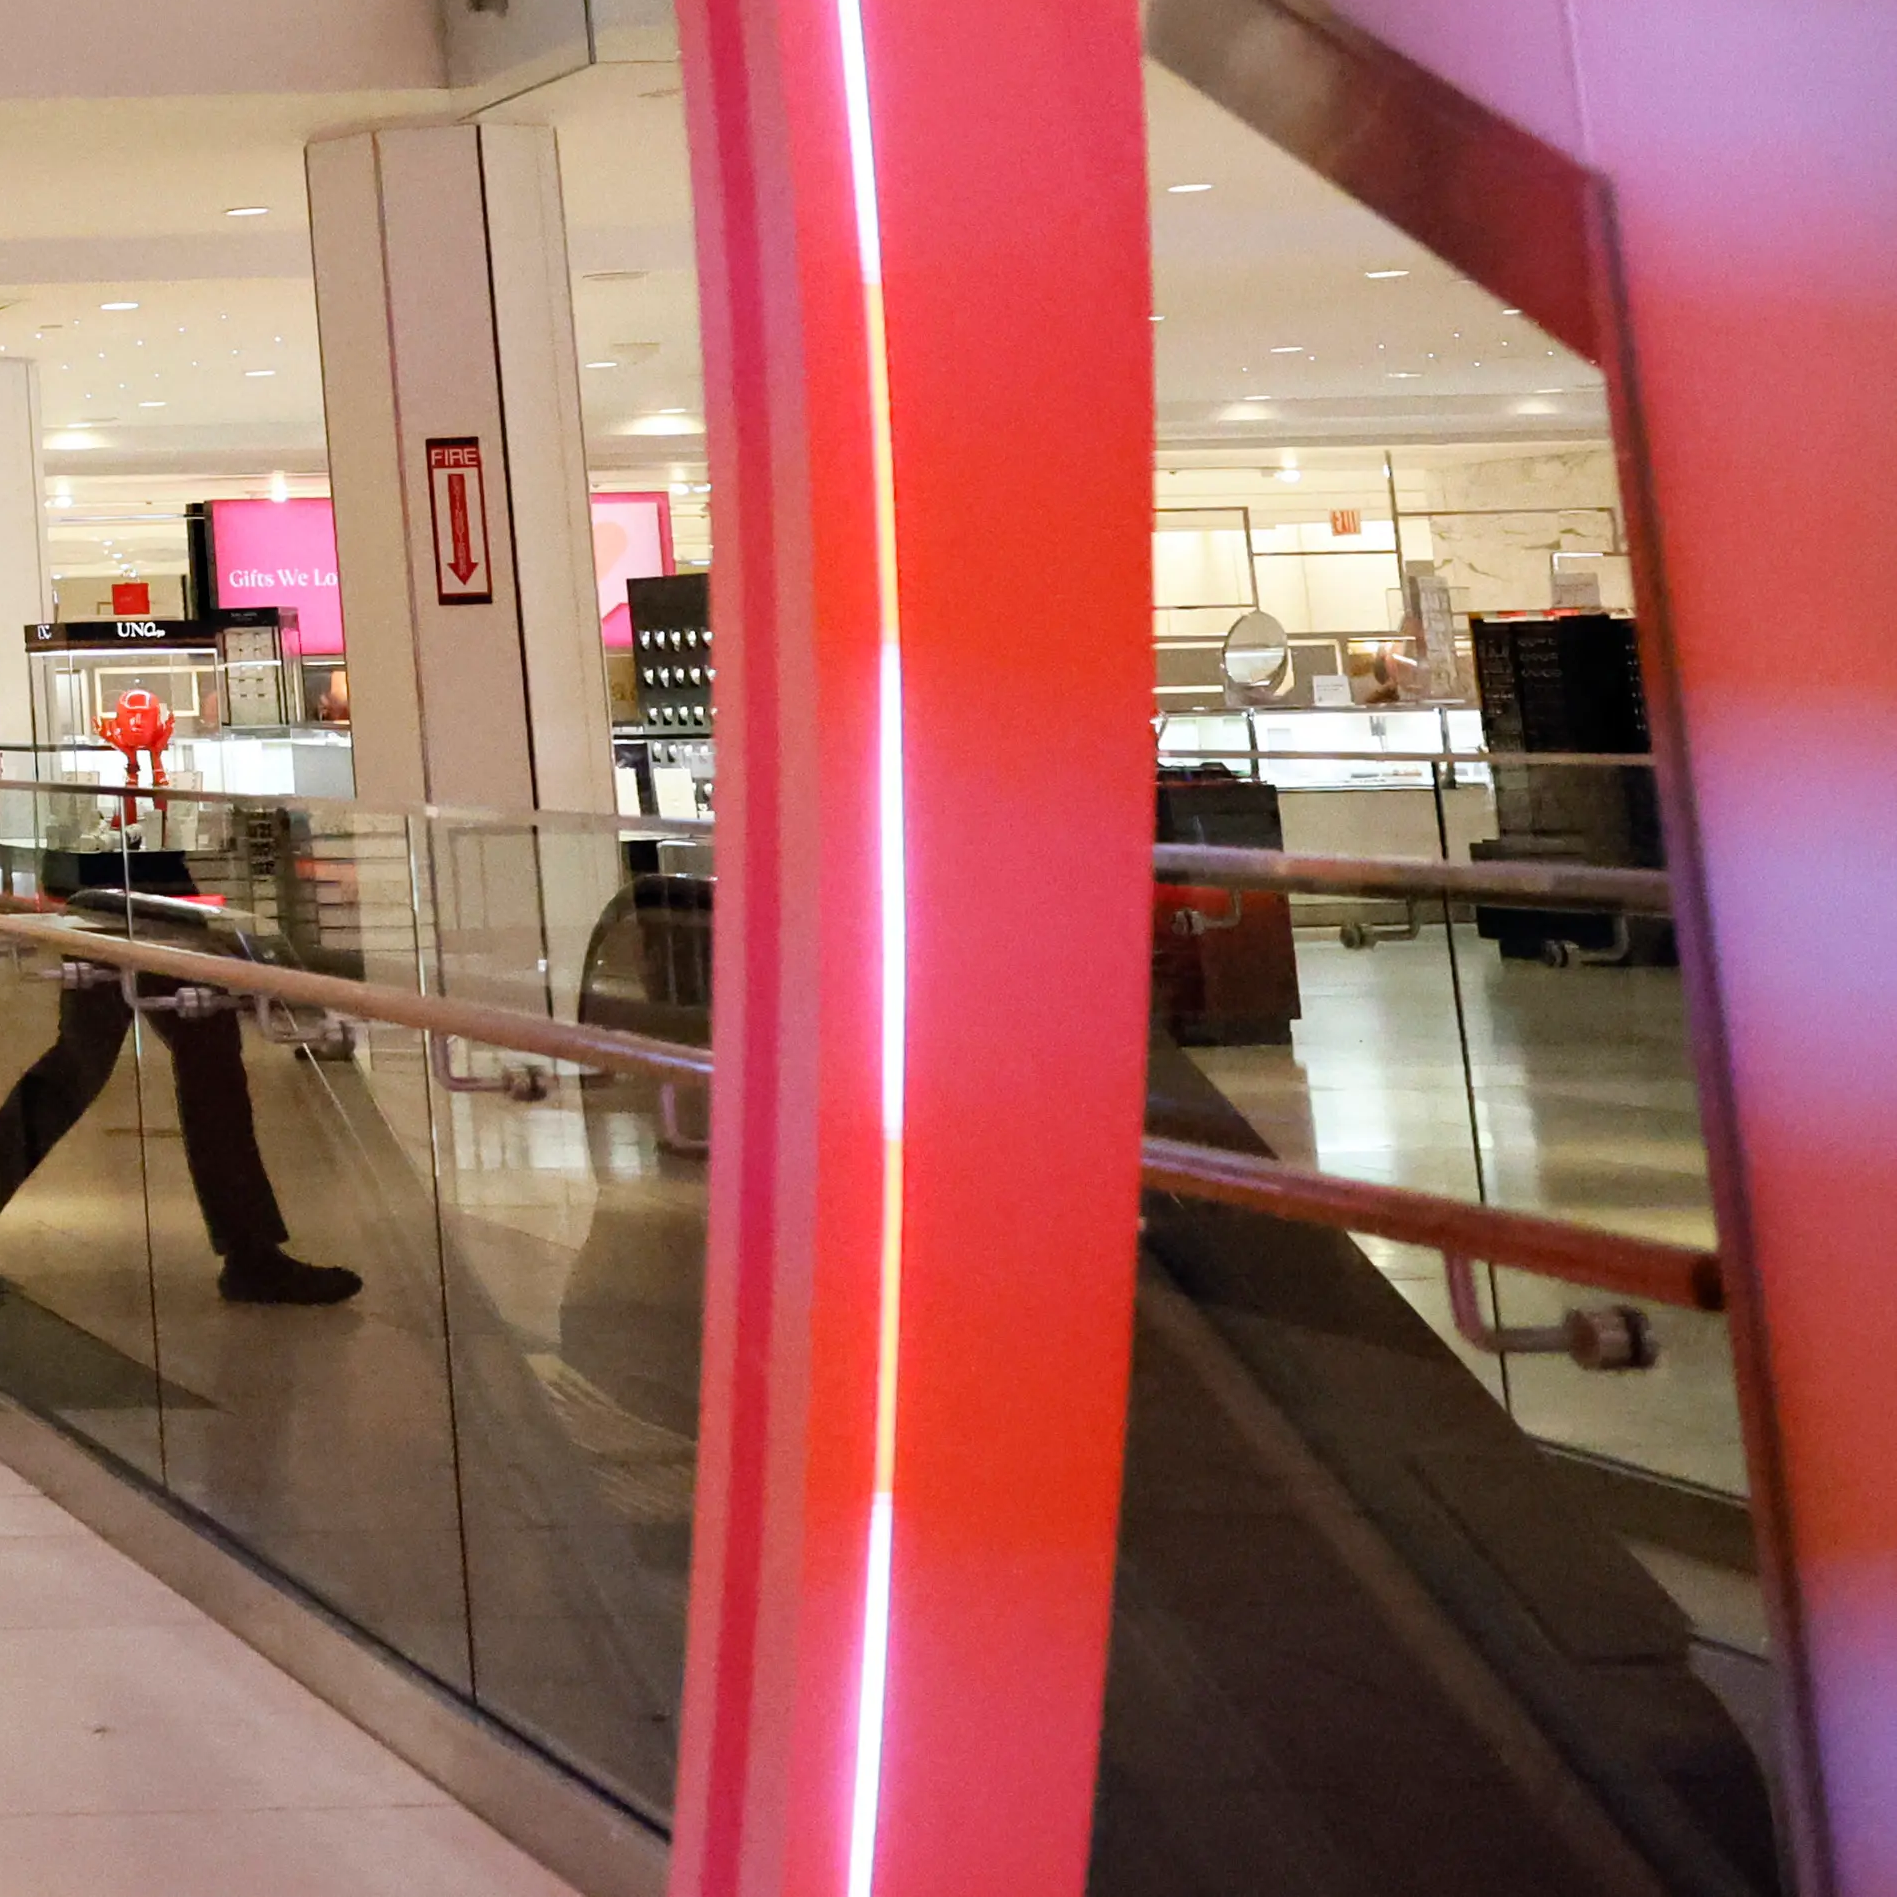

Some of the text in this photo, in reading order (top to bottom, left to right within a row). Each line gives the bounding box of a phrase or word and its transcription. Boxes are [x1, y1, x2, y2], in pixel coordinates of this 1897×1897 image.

[430, 447, 478, 466] FIRE
[228, 567, 338, 588] Gifts We Lo
